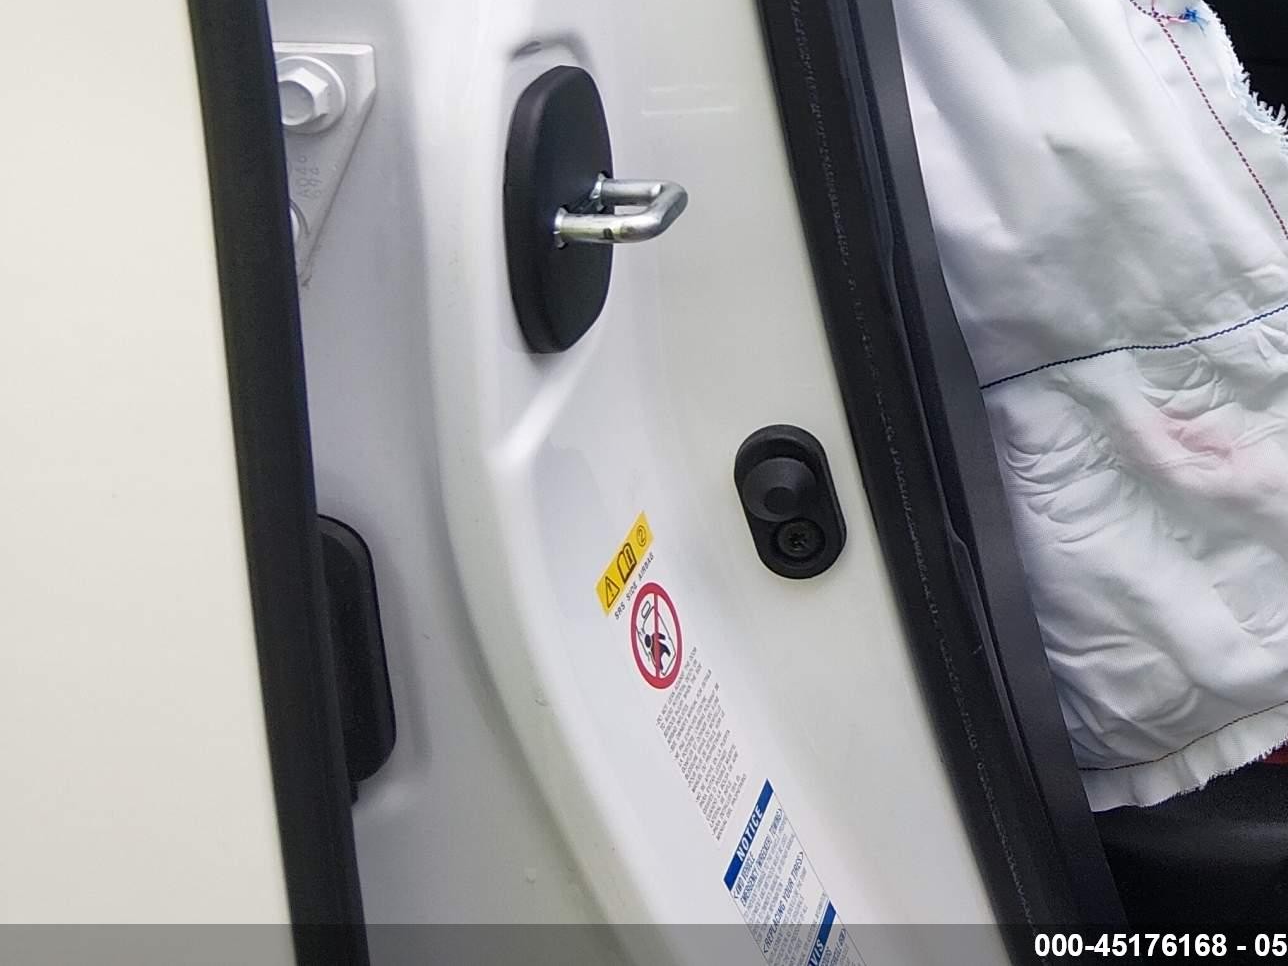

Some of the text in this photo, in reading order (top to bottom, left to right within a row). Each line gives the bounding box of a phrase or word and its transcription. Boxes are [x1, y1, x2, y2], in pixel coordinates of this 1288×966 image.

[615, 602, 626, 620] SRS
[638, 552, 654, 581] AIRBAG
[736, 804, 764, 862] NOTICE
[782, 876, 795, 902] YOUR
